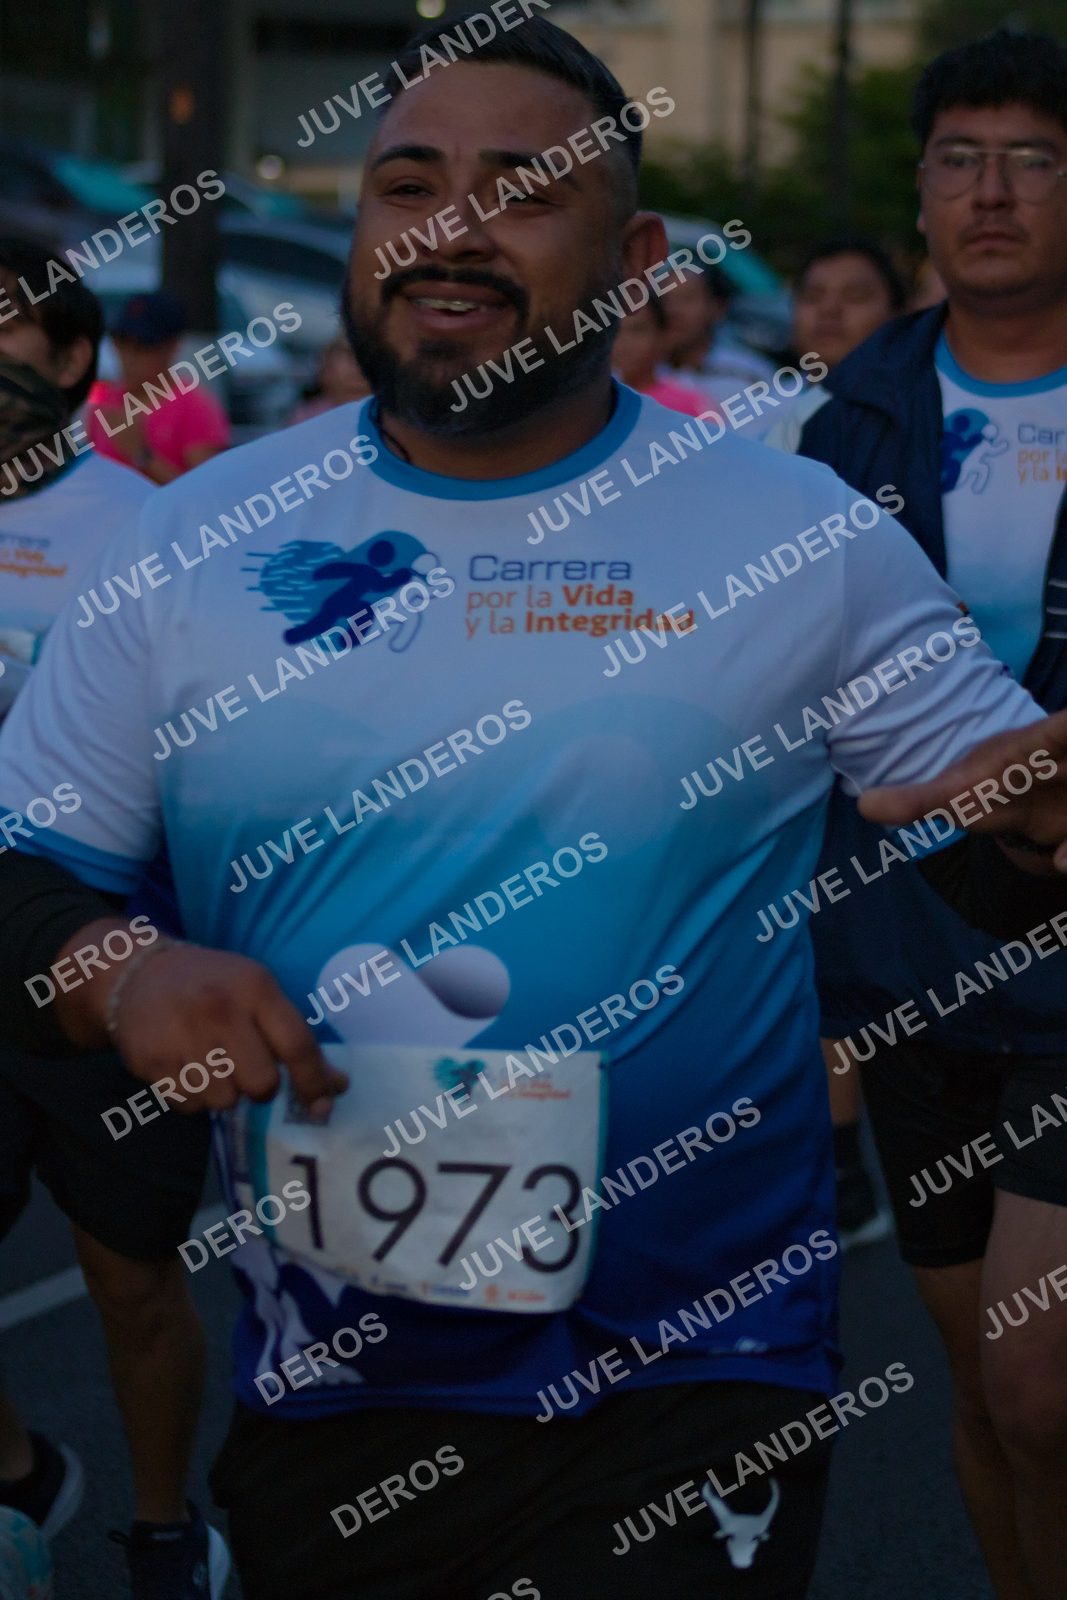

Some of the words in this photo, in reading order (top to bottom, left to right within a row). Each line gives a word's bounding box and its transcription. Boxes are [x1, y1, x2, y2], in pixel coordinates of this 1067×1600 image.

[469, 554, 632, 582] Carrera
[467, 590, 517, 614] por
[527, 585, 552, 608] la
[562, 584, 635, 607] Vida
[465, 617, 480, 640] y
[490, 611, 515, 634] la
[525, 608, 694, 637] Integridad
[290, 1155, 582, 1273] 1973
